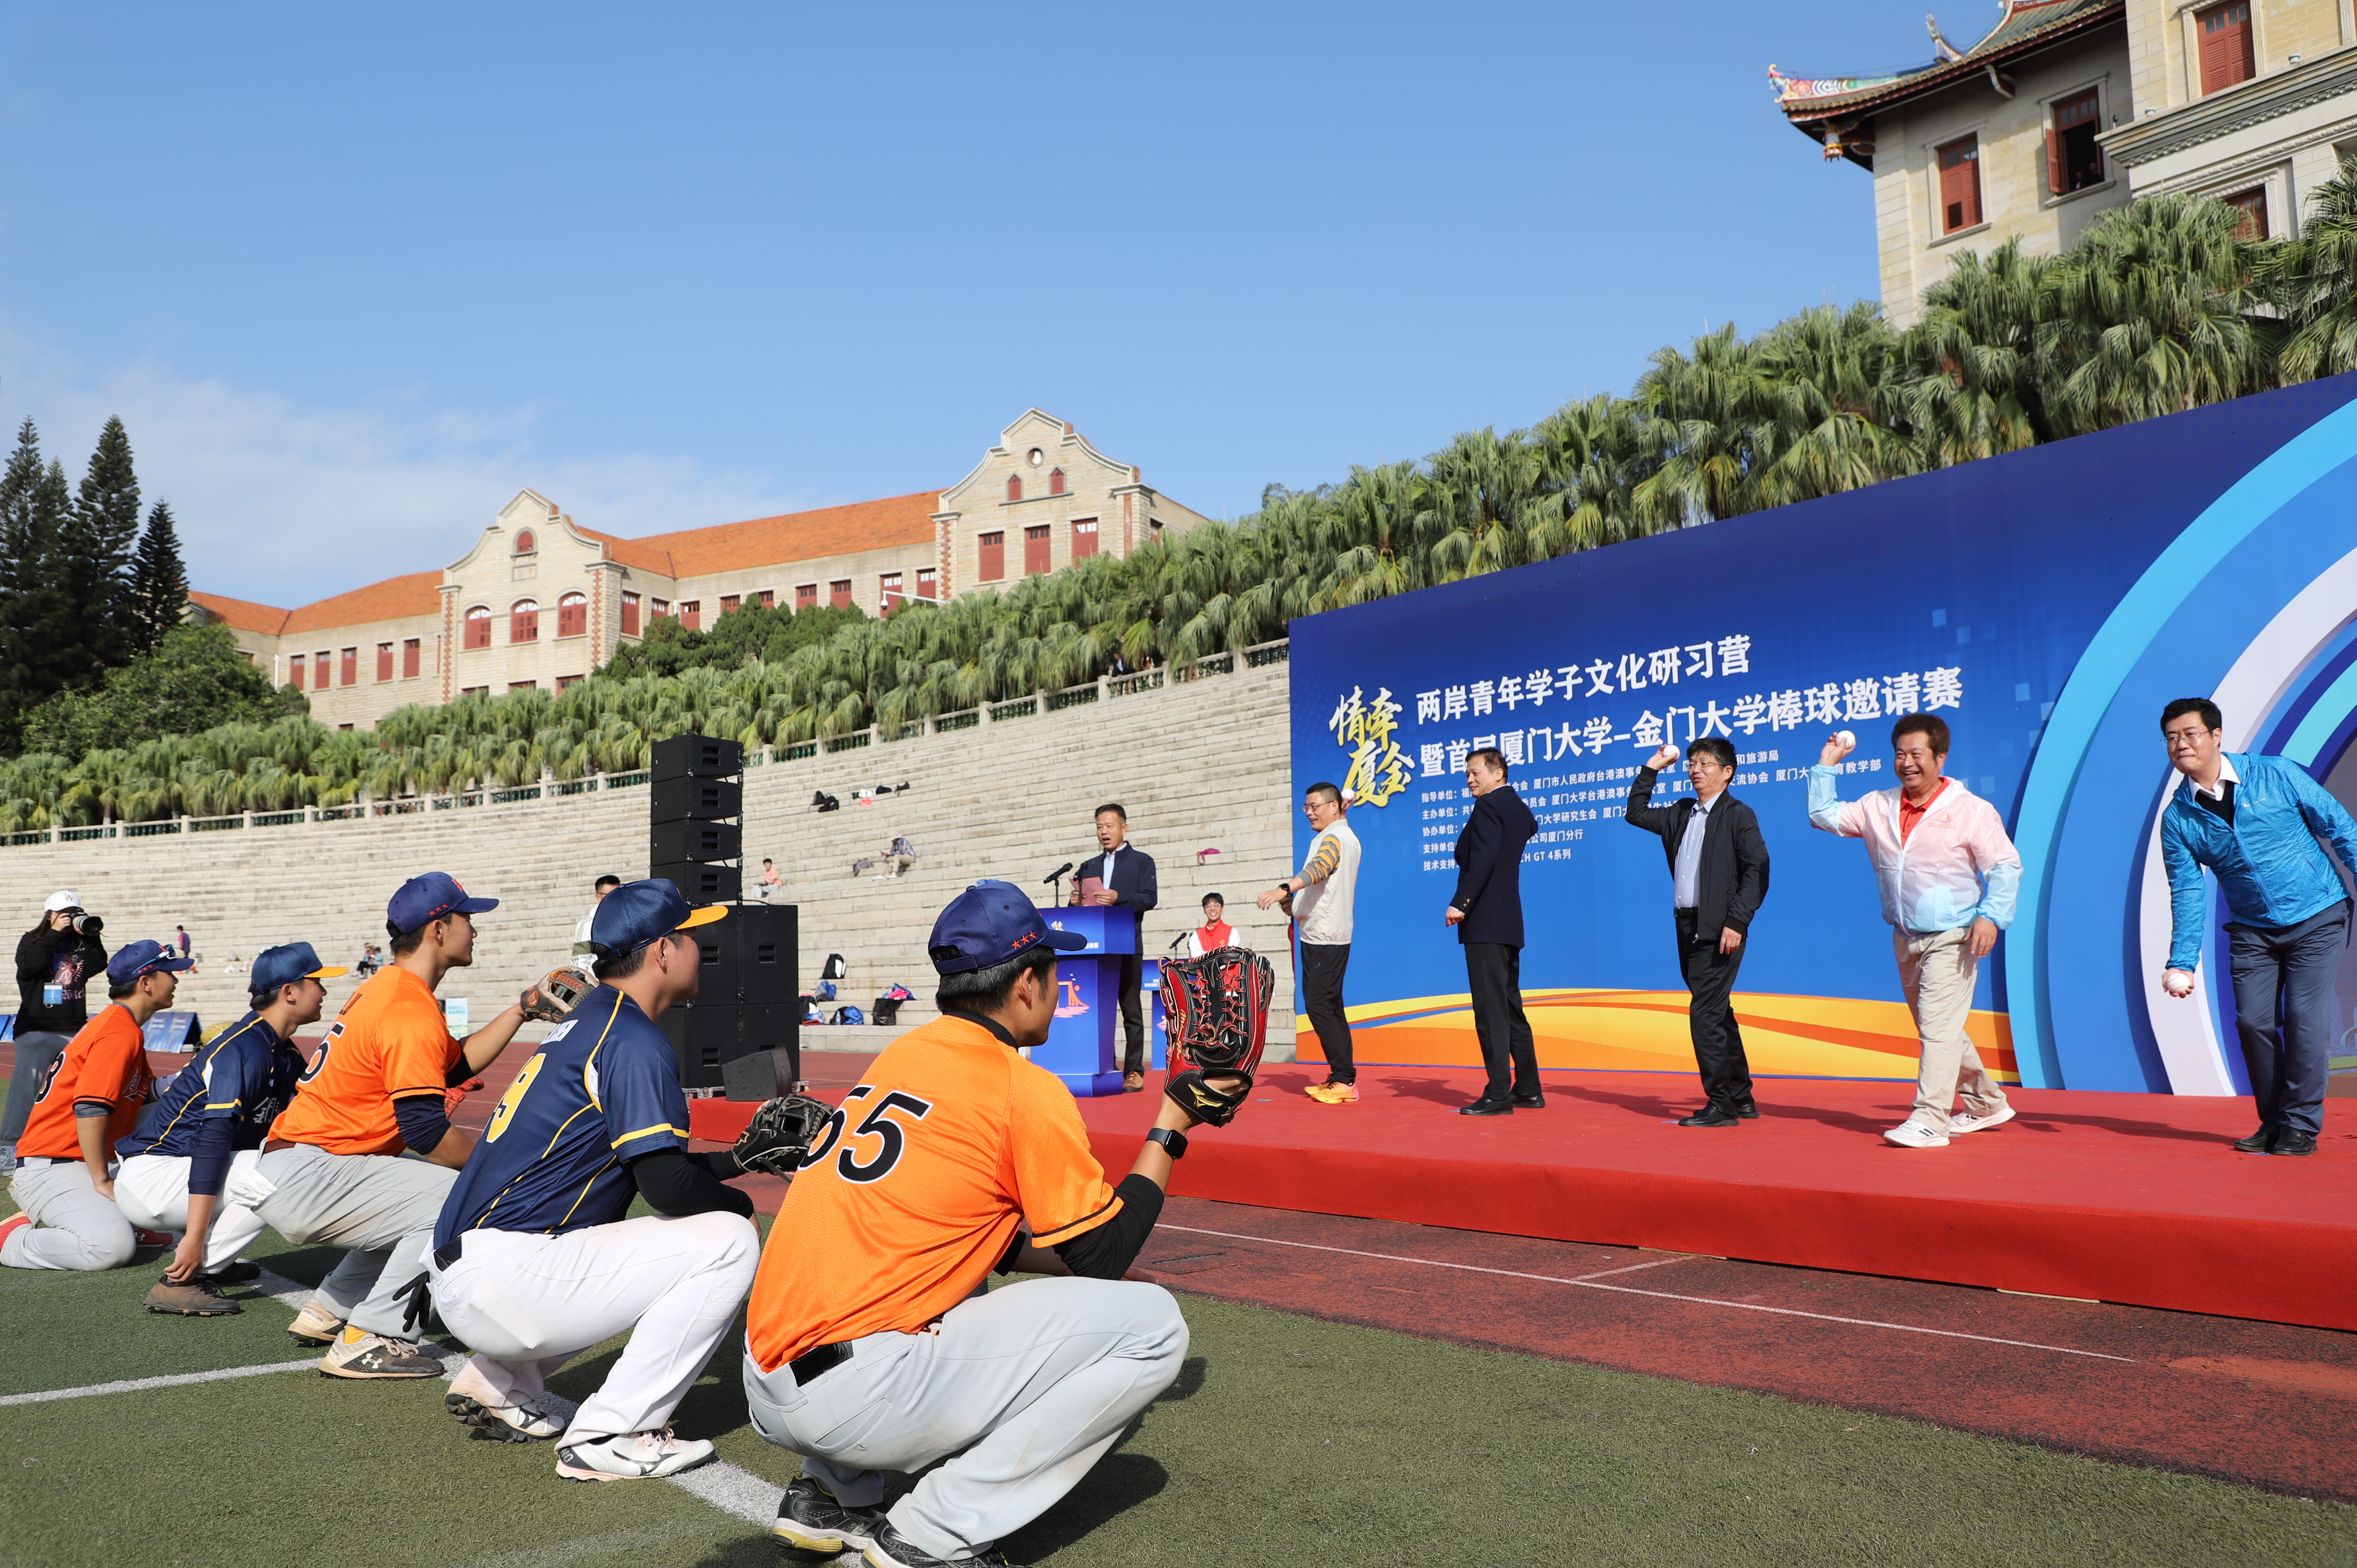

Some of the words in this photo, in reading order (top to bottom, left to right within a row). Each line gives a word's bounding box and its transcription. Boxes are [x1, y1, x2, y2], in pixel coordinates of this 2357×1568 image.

[1416, 634, 1751, 725] 两岸青年学子文化研习营
[1534, 851, 1546, 862] GT
